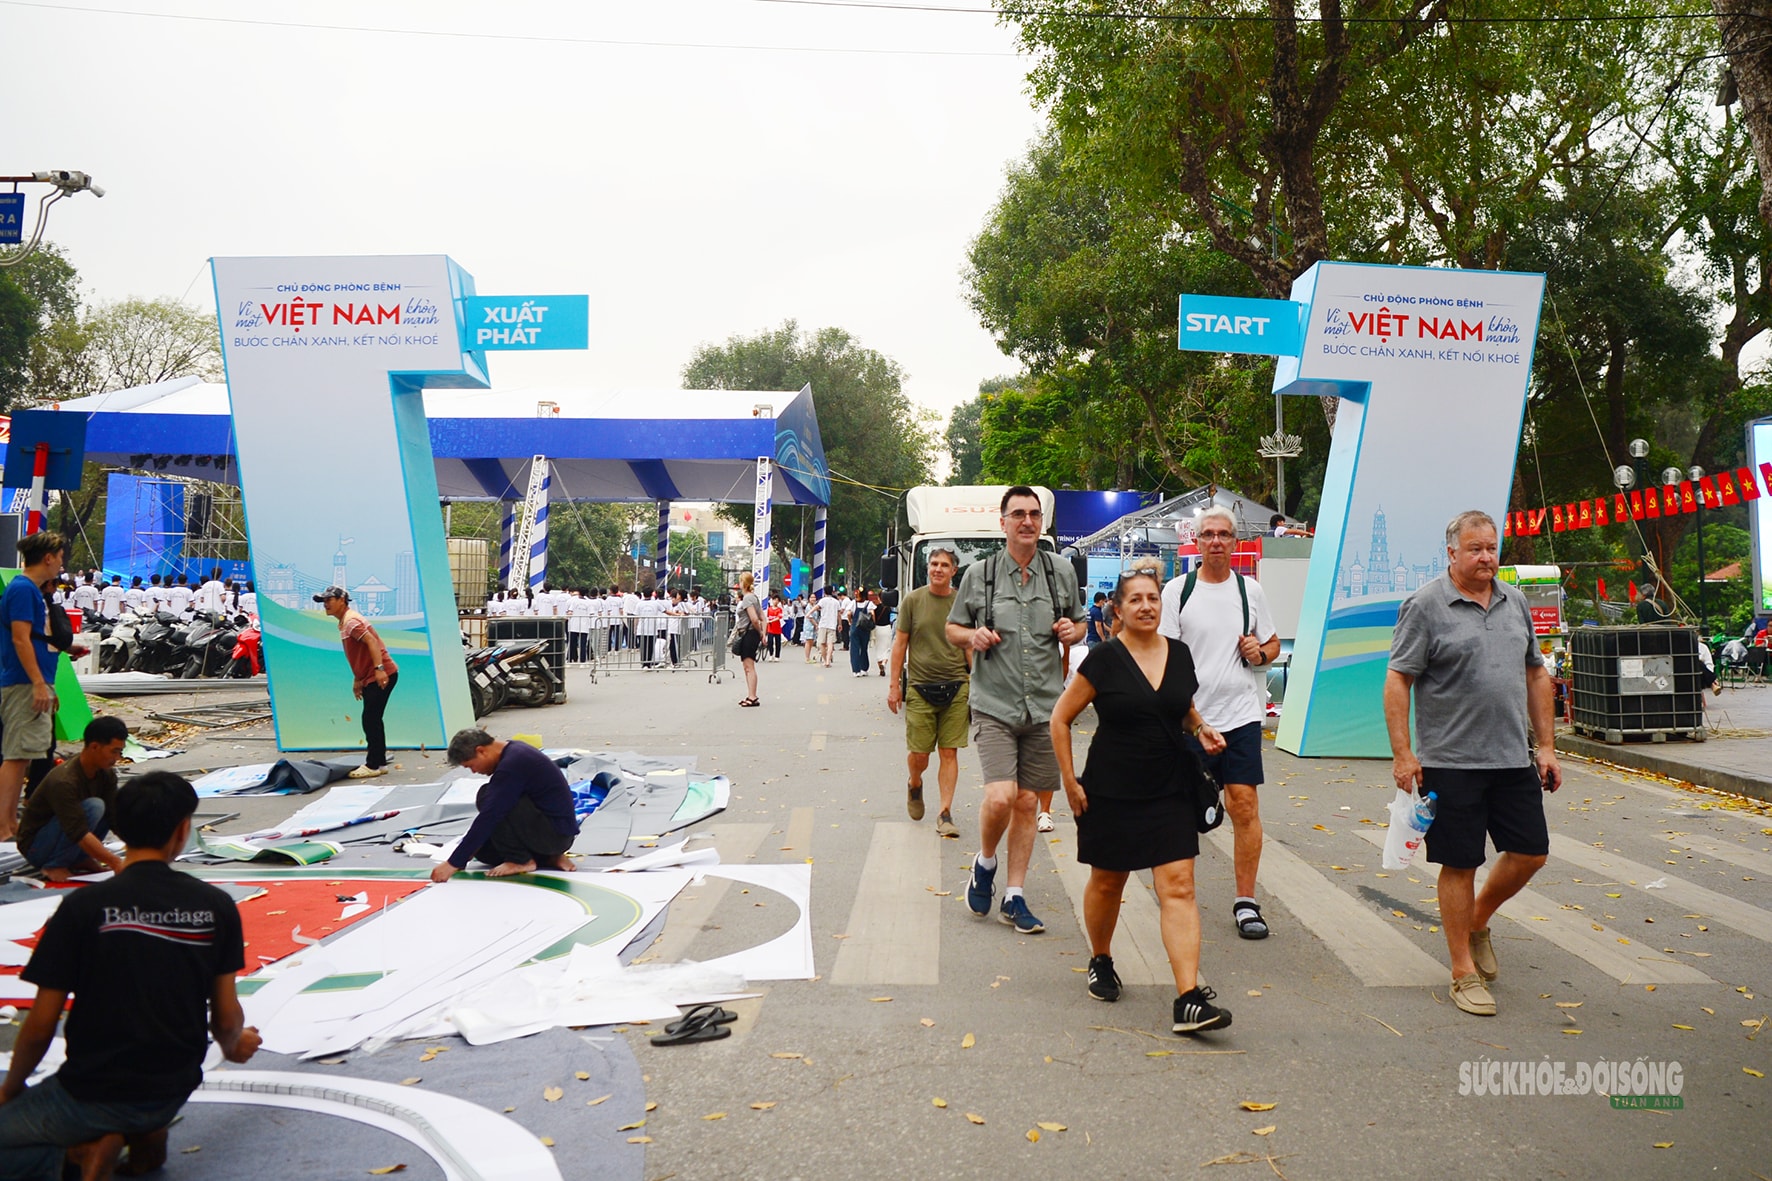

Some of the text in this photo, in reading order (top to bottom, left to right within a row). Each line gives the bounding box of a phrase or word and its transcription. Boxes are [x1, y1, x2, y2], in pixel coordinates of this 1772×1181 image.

[277, 282, 401, 293] CHỦ ĐỘNG PHÒNG BỆNH
[1364, 292, 1484, 309] CHỦ ĐỘNG PHÒNG BỆNH
[260, 295, 400, 333] VIỆT NAM
[484, 300, 549, 323] XUẤT
[477, 323, 542, 345] PHÁT
[1186, 313, 1270, 336] START
[1348, 306, 1483, 343] VIỆT NAM
[234, 335, 269, 347] BƯỚC
[311, 336, 350, 347] XANH,
[353, 333, 375, 346] KẾT
[1323, 343, 1357, 356] BƯỚC
[1399, 349, 1435, 360] XANH,
[1438, 348, 1459, 361] KẾT
[944, 506, 1001, 514] ISUZ
[104, 906, 215, 926] Balenciaga
